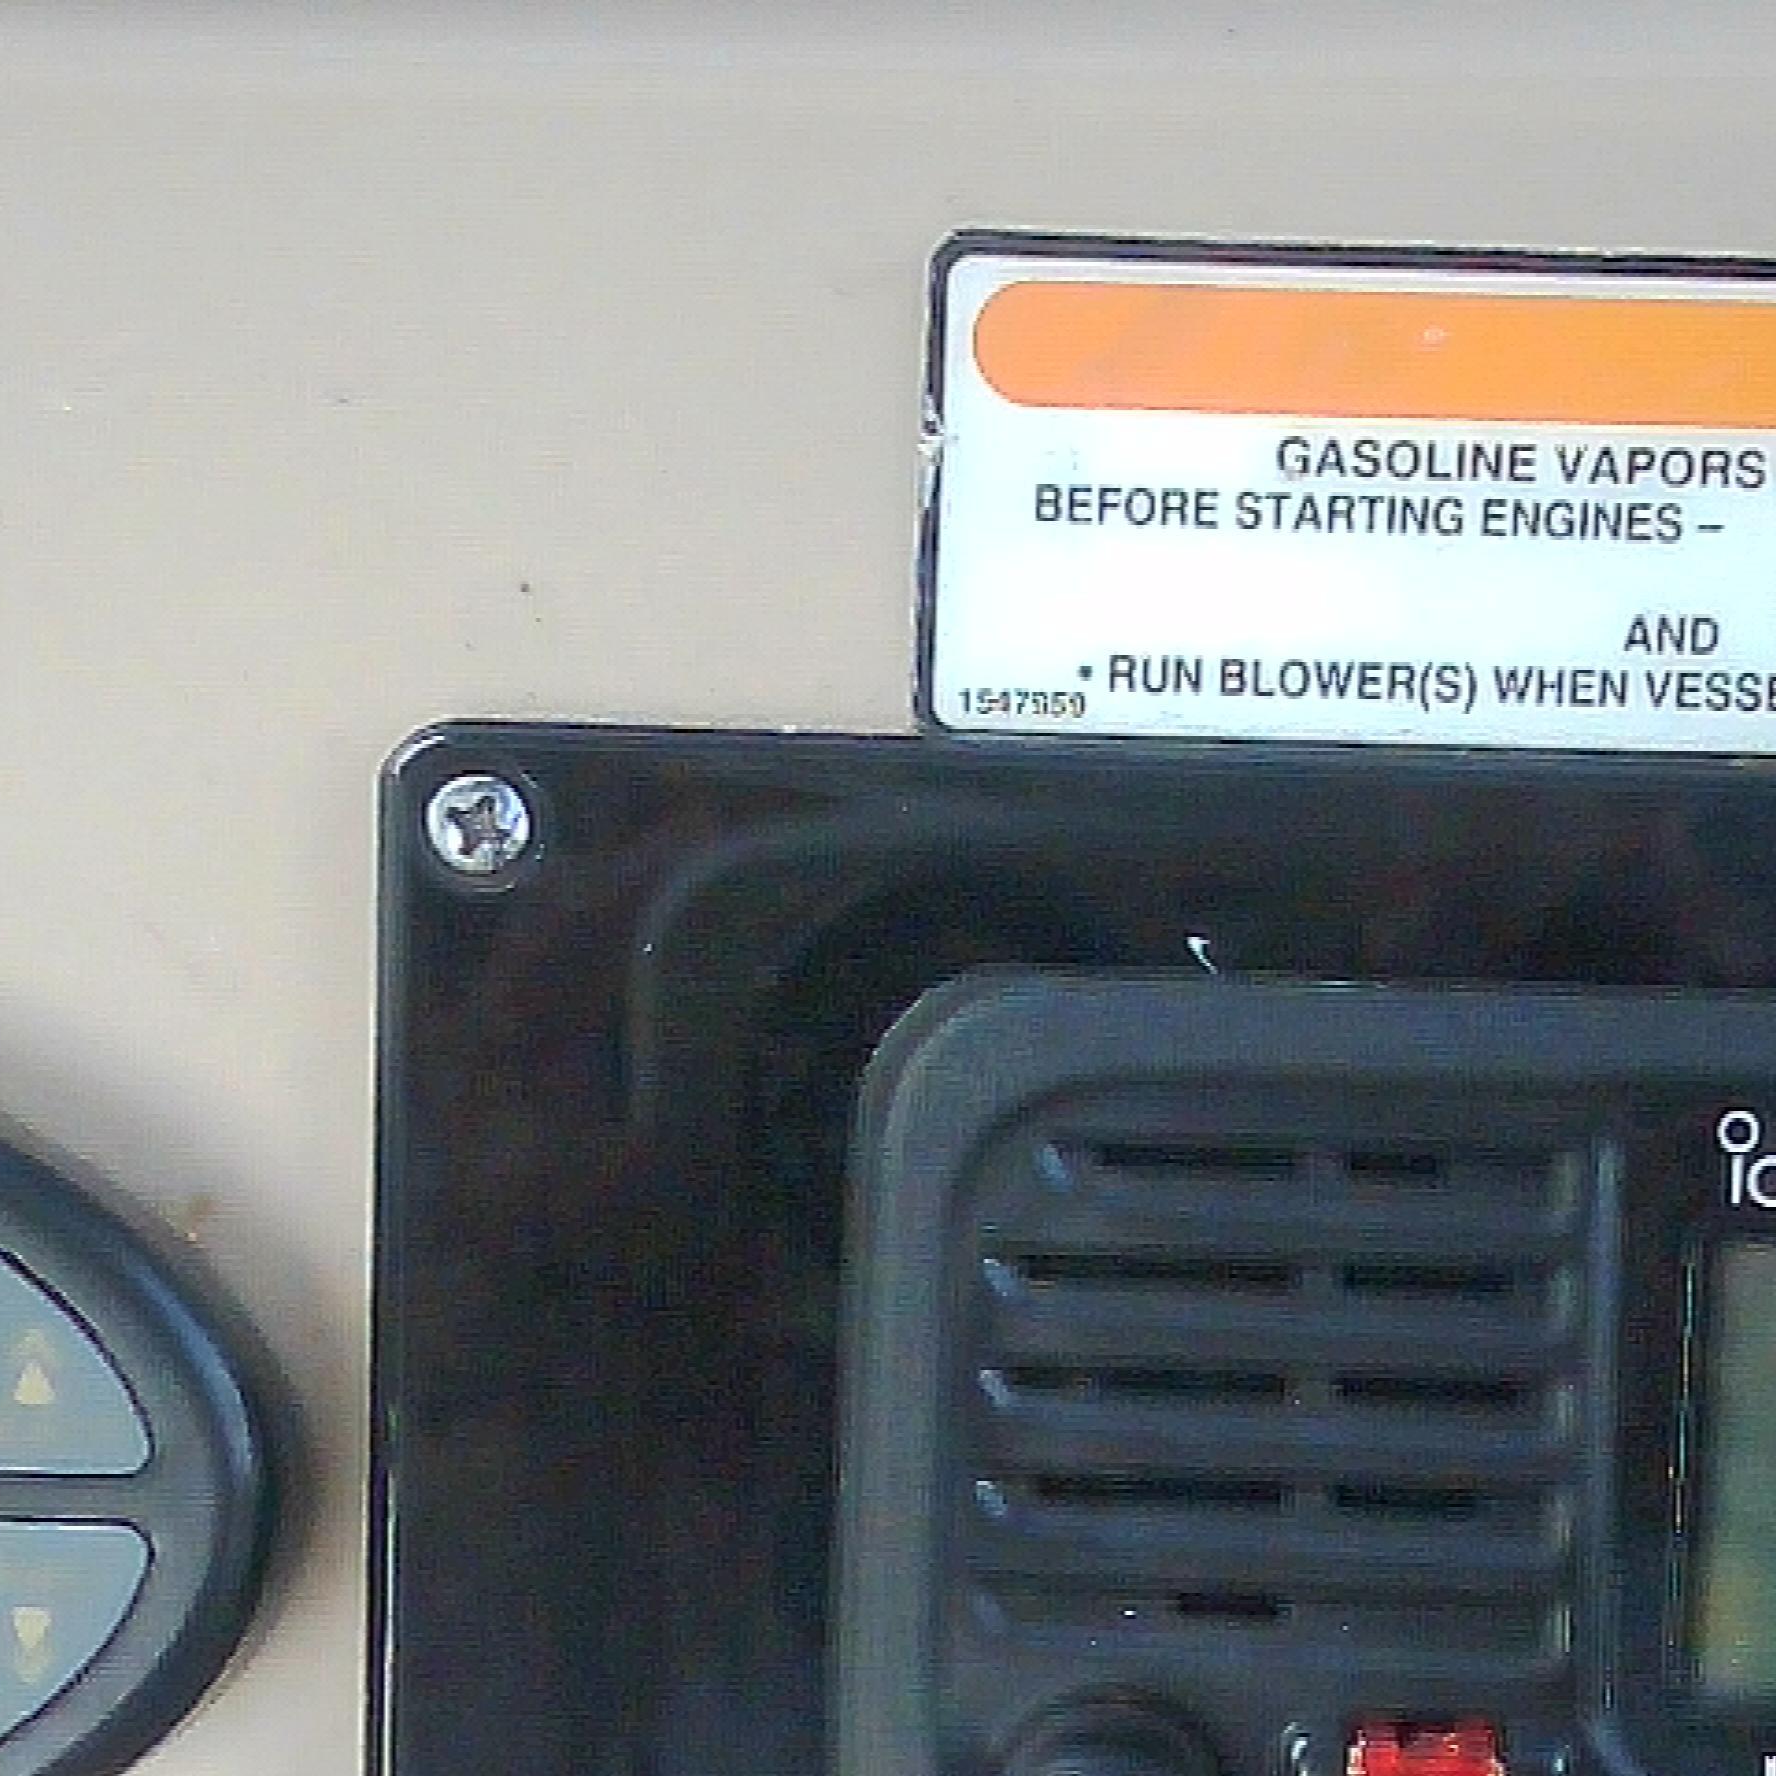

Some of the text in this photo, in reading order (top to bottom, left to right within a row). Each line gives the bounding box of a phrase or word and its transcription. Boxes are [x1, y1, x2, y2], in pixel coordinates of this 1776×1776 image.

[1277, 438, 1536, 482] GASOLINE
[1557, 446, 1765, 489] VAPORS
[1035, 485, 1219, 529] BEFORE
[1235, 491, 1463, 537] STARTING
[1480, 501, 1683, 542] ENGINES
[1624, 616, 1717, 655] AND
[1110, 656, 1201, 693] RUN
[1221, 660, 1476, 712] BLOWER(S)
[1494, 668, 1625, 707] WHEN
